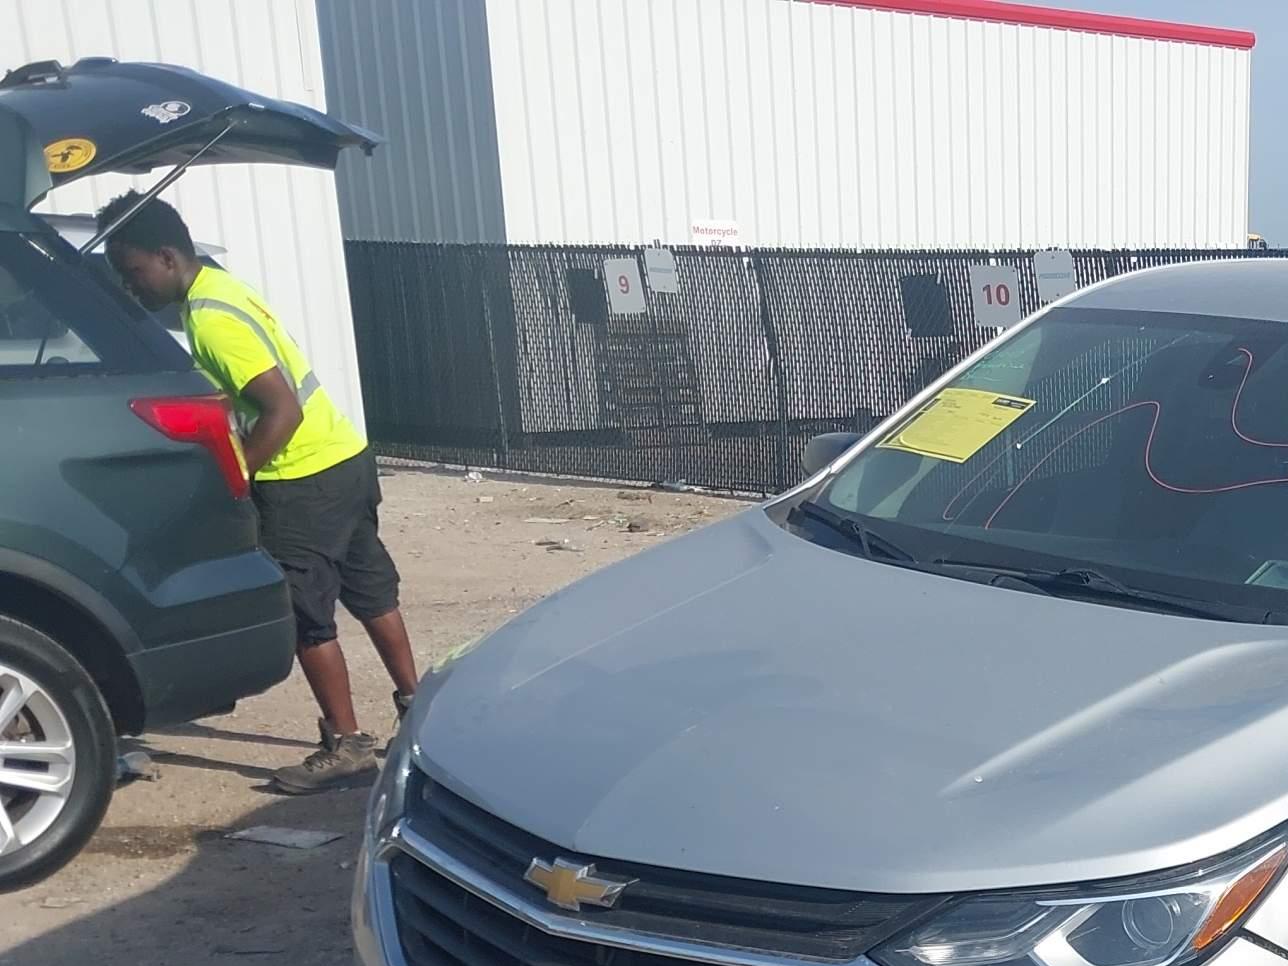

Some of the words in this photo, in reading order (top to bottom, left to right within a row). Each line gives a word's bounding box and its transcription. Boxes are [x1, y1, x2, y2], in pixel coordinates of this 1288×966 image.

[692, 226, 738, 238] Motorcycle
[618, 275, 630, 294] 9
[982, 284, 1010, 306] 10
